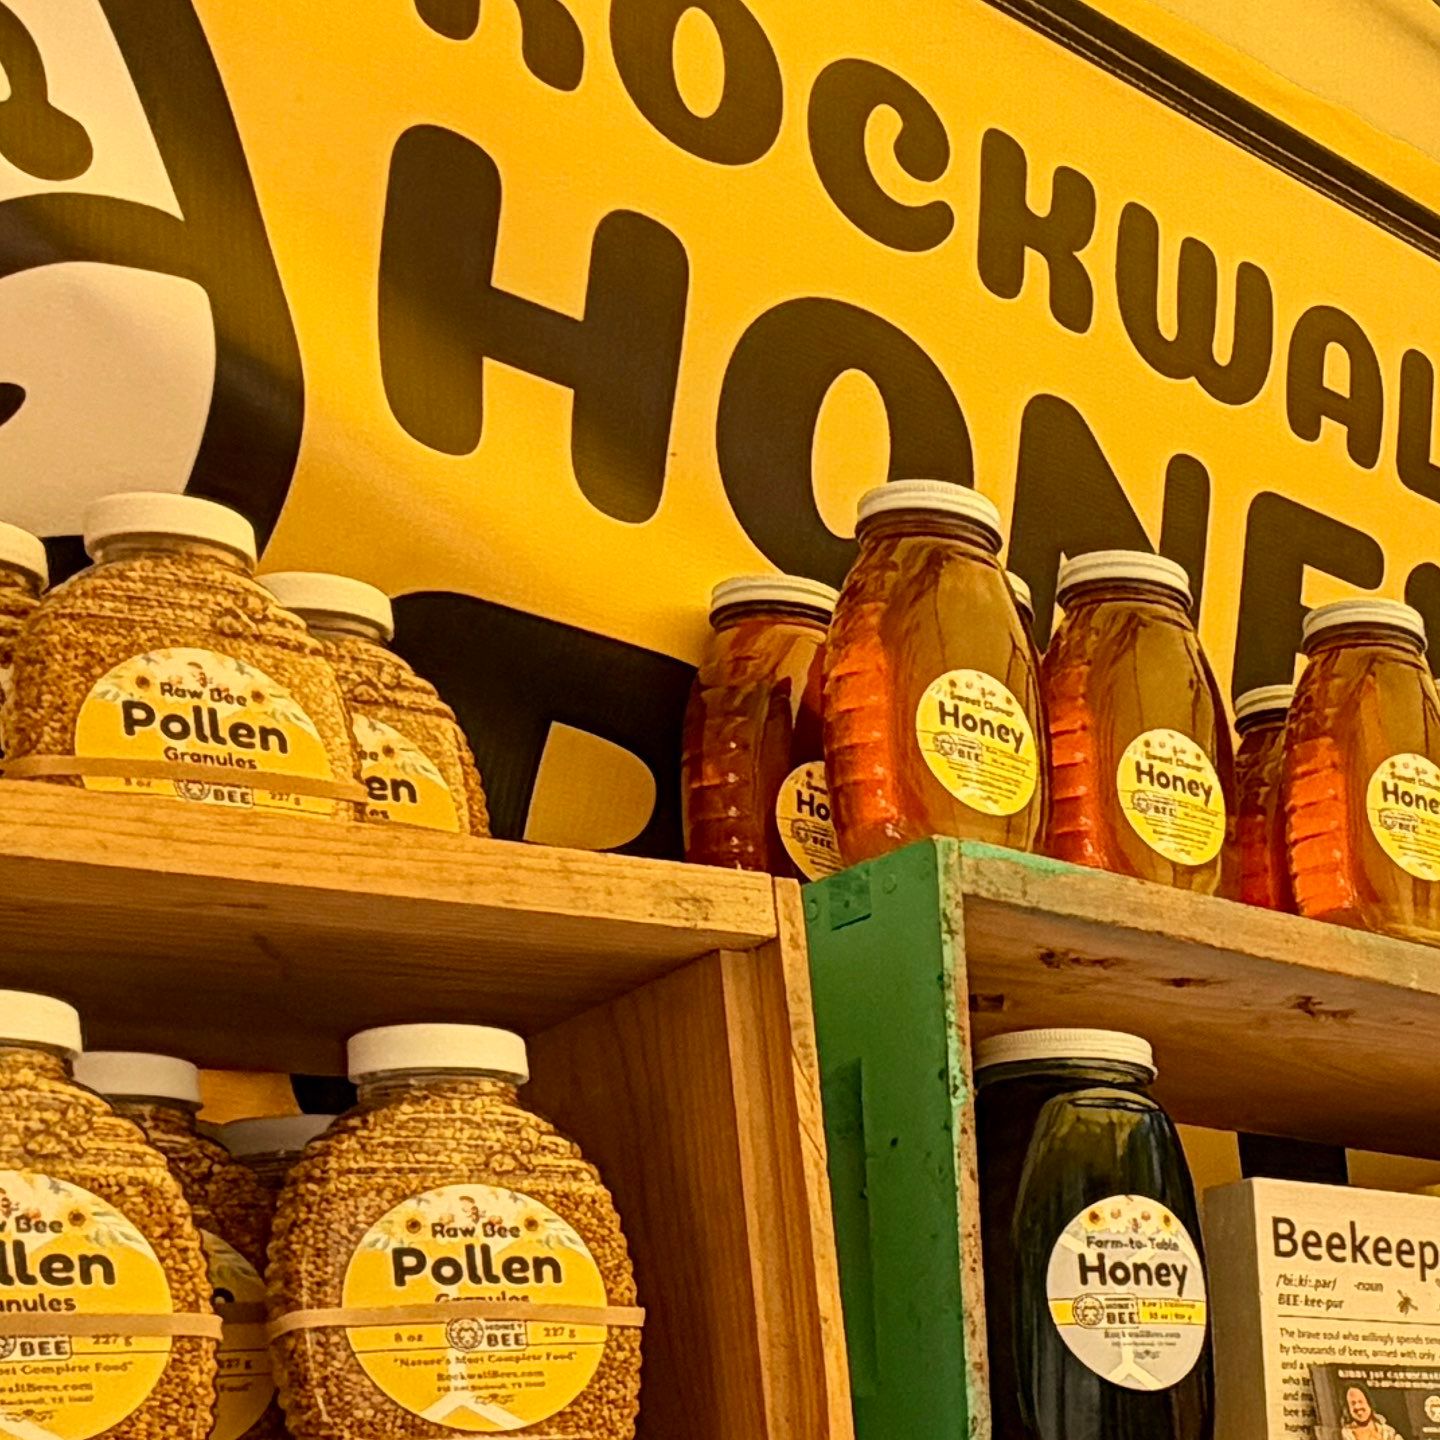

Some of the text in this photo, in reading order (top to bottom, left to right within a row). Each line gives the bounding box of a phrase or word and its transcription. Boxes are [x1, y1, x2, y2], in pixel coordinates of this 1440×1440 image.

[161, 682, 247, 707] Raw Bee
[122, 700, 289, 754] Pollen
[939, 700, 1024, 754] Honey
[164, 747, 257, 770] Granules
[1136, 761, 1212, 807] Honey
[213, 788, 251, 806] BEE
[16, 1215, 63, 1233] Bee
[431, 1222, 521, 1238] Raw Bee
[392, 1243, 563, 1287] Pollen
[1078, 1252, 1188, 1297] Honey
[1107, 1312, 1136, 1324] BEE
[20, 1340, 68, 1356] BEE
[487, 1333, 524, 1347] BEE
